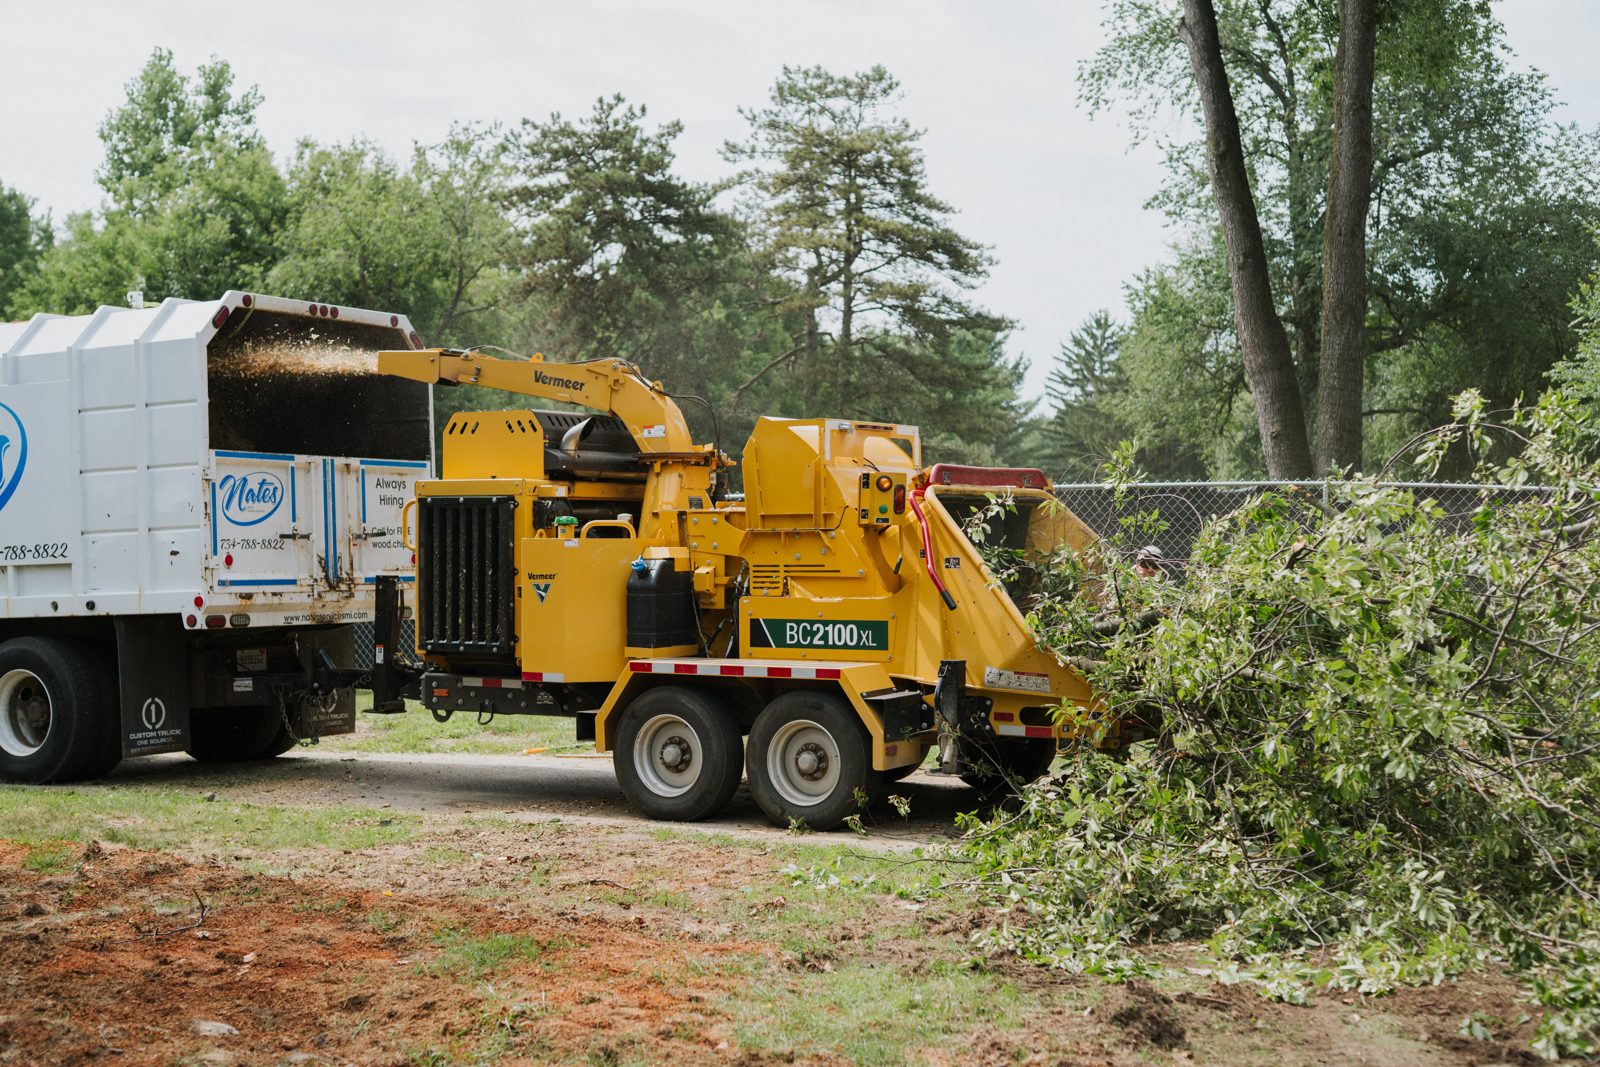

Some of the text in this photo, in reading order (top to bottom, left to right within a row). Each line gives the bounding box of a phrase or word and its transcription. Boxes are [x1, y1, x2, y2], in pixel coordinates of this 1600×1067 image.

[534, 370, 585, 391] Vermeer
[375, 478, 406, 491] Always
[219, 474, 278, 512] Nates
[379, 494, 404, 508] Hiring
[386, 527, 395, 536] for
[397, 526, 411, 535] FE
[220, 537, 285, 550] 734-788-8822
[372, 539, 391, 548] wood
[528, 572, 556, 580] Vermeer
[129, 729, 182, 740] CUSTOM TRUCK
